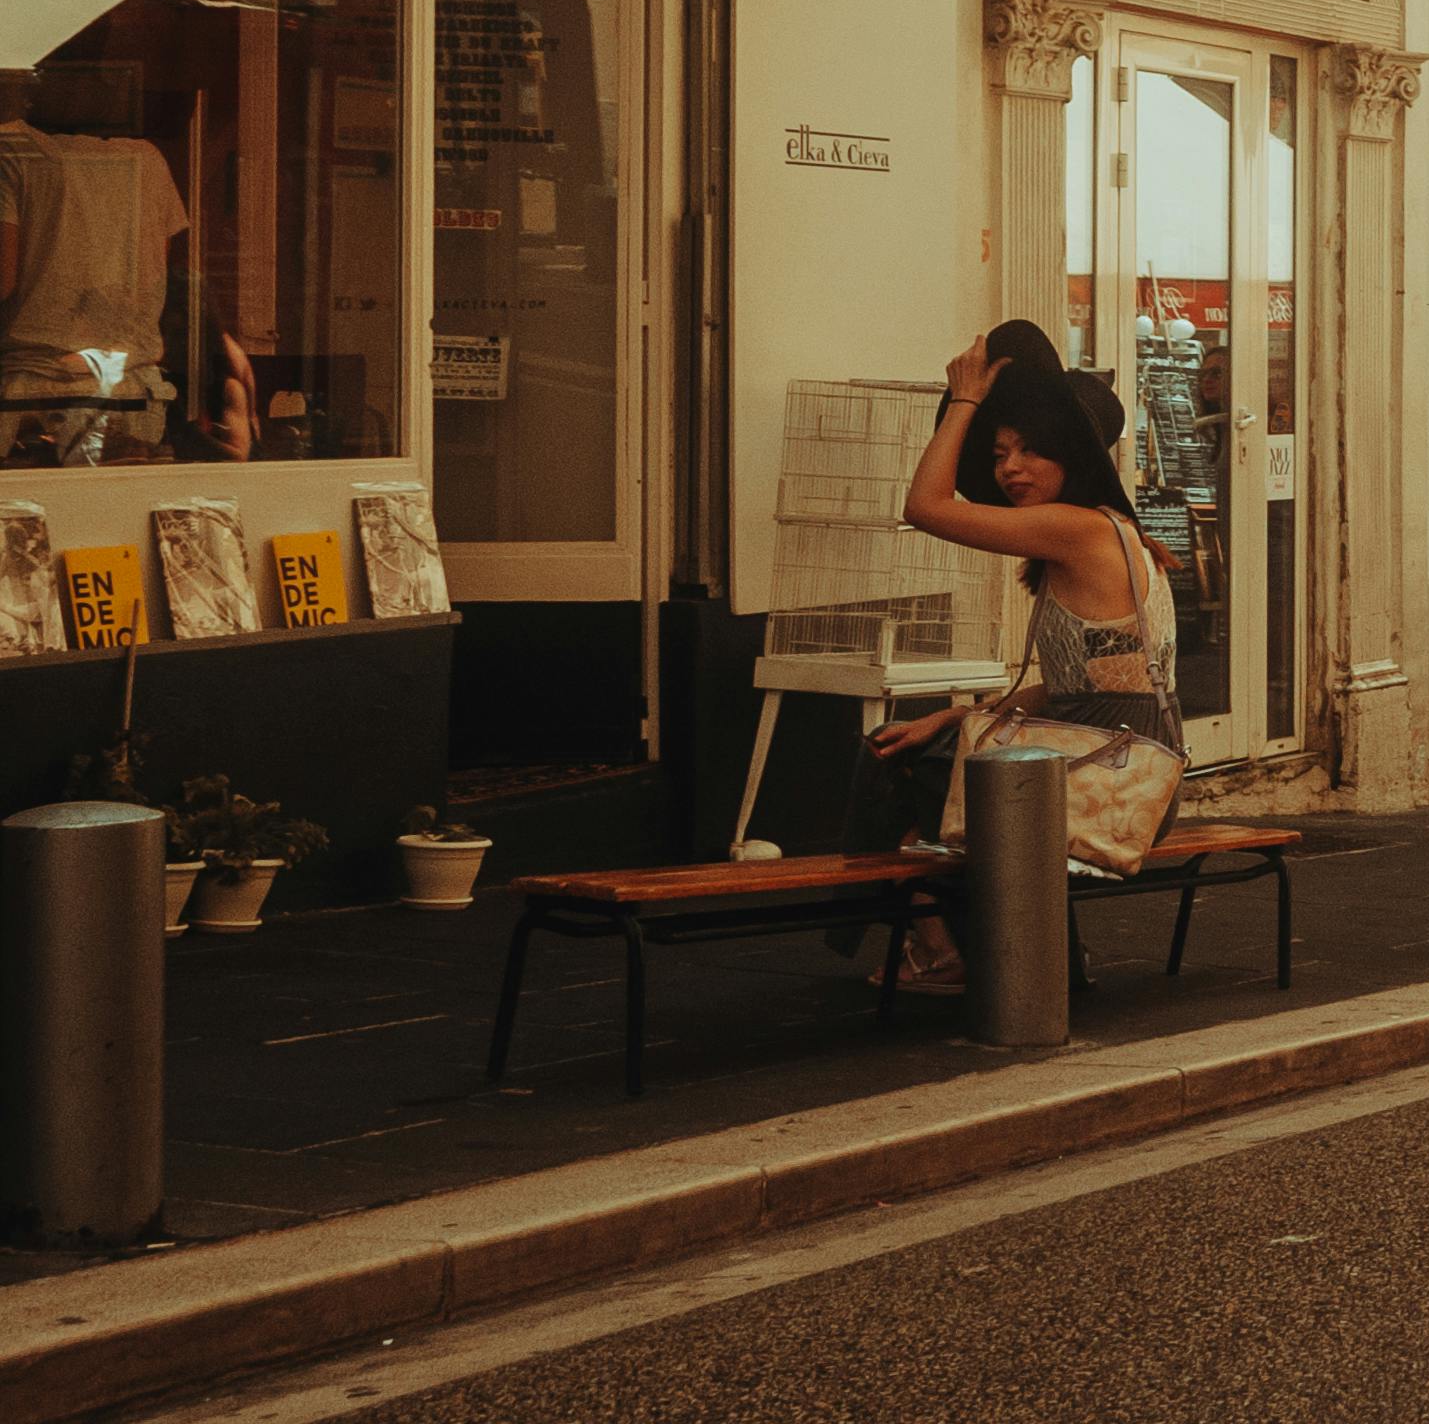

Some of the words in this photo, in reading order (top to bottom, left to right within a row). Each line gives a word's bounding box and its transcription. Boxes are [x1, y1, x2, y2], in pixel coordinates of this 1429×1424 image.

[786, 123, 826, 163] elka
[830, 139, 843, 164] &
[847, 139, 889, 167] Cieva
[279, 555, 319, 582] EN
[72, 571, 115, 599] EN
[284, 582, 320, 608] DE
[76, 600, 116, 628] DE
